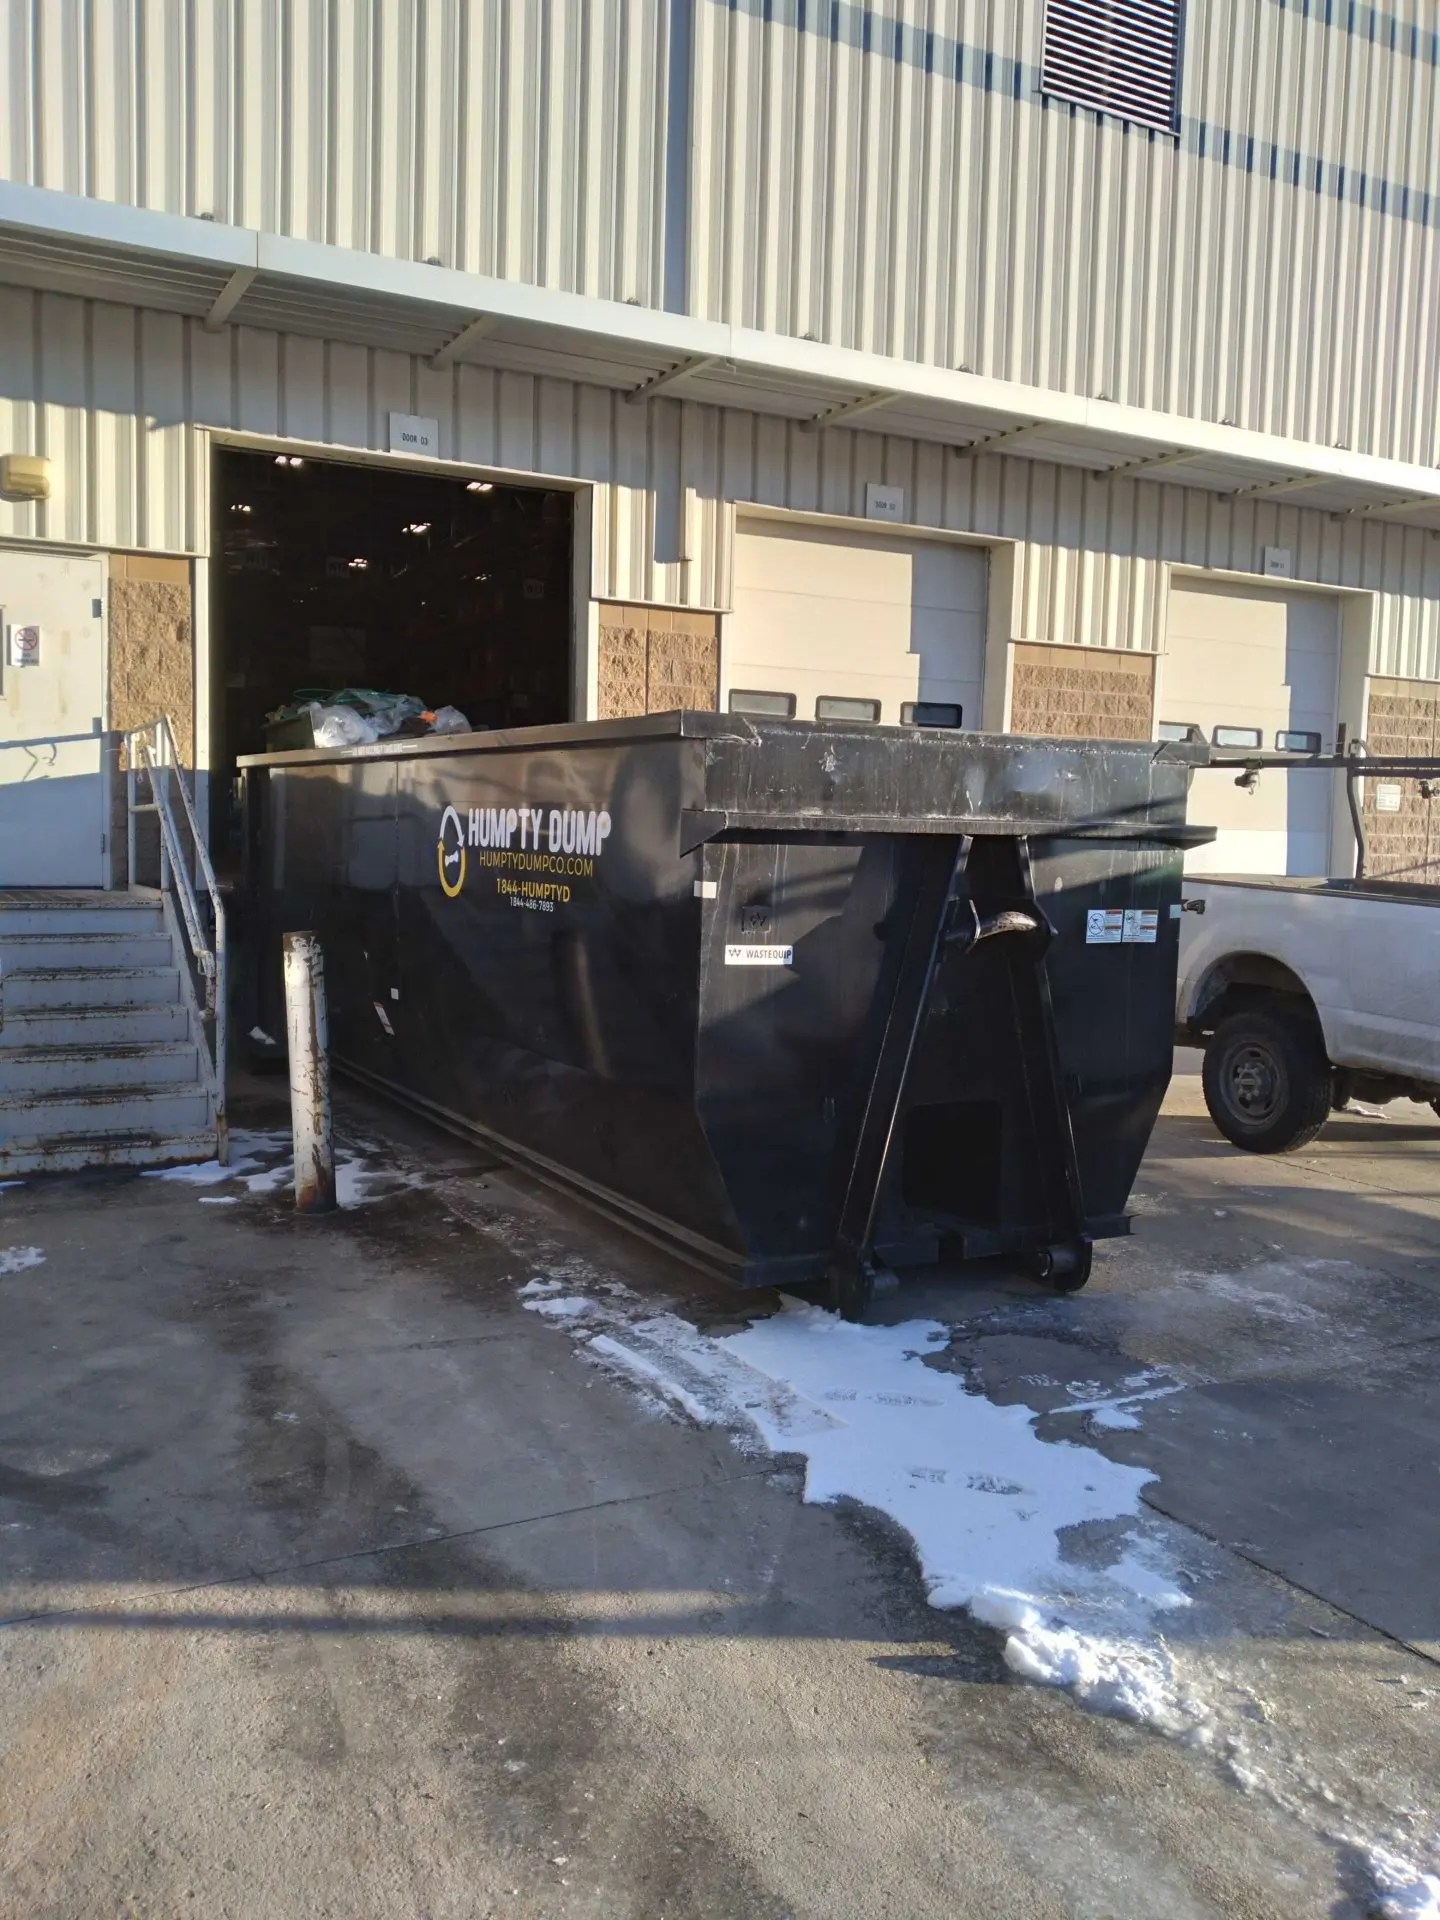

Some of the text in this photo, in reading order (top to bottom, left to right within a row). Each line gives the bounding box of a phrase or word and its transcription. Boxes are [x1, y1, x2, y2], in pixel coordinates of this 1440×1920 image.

[402, 432, 417, 443] DOOR
[468, 808, 612, 856] HUMPTY DUMP
[479, 851, 593, 876] HUMPTYDUMPCO.COM
[496, 878, 571, 902] 1844-HUMPTYD
[746, 949, 792, 959] WASTEQUIP
